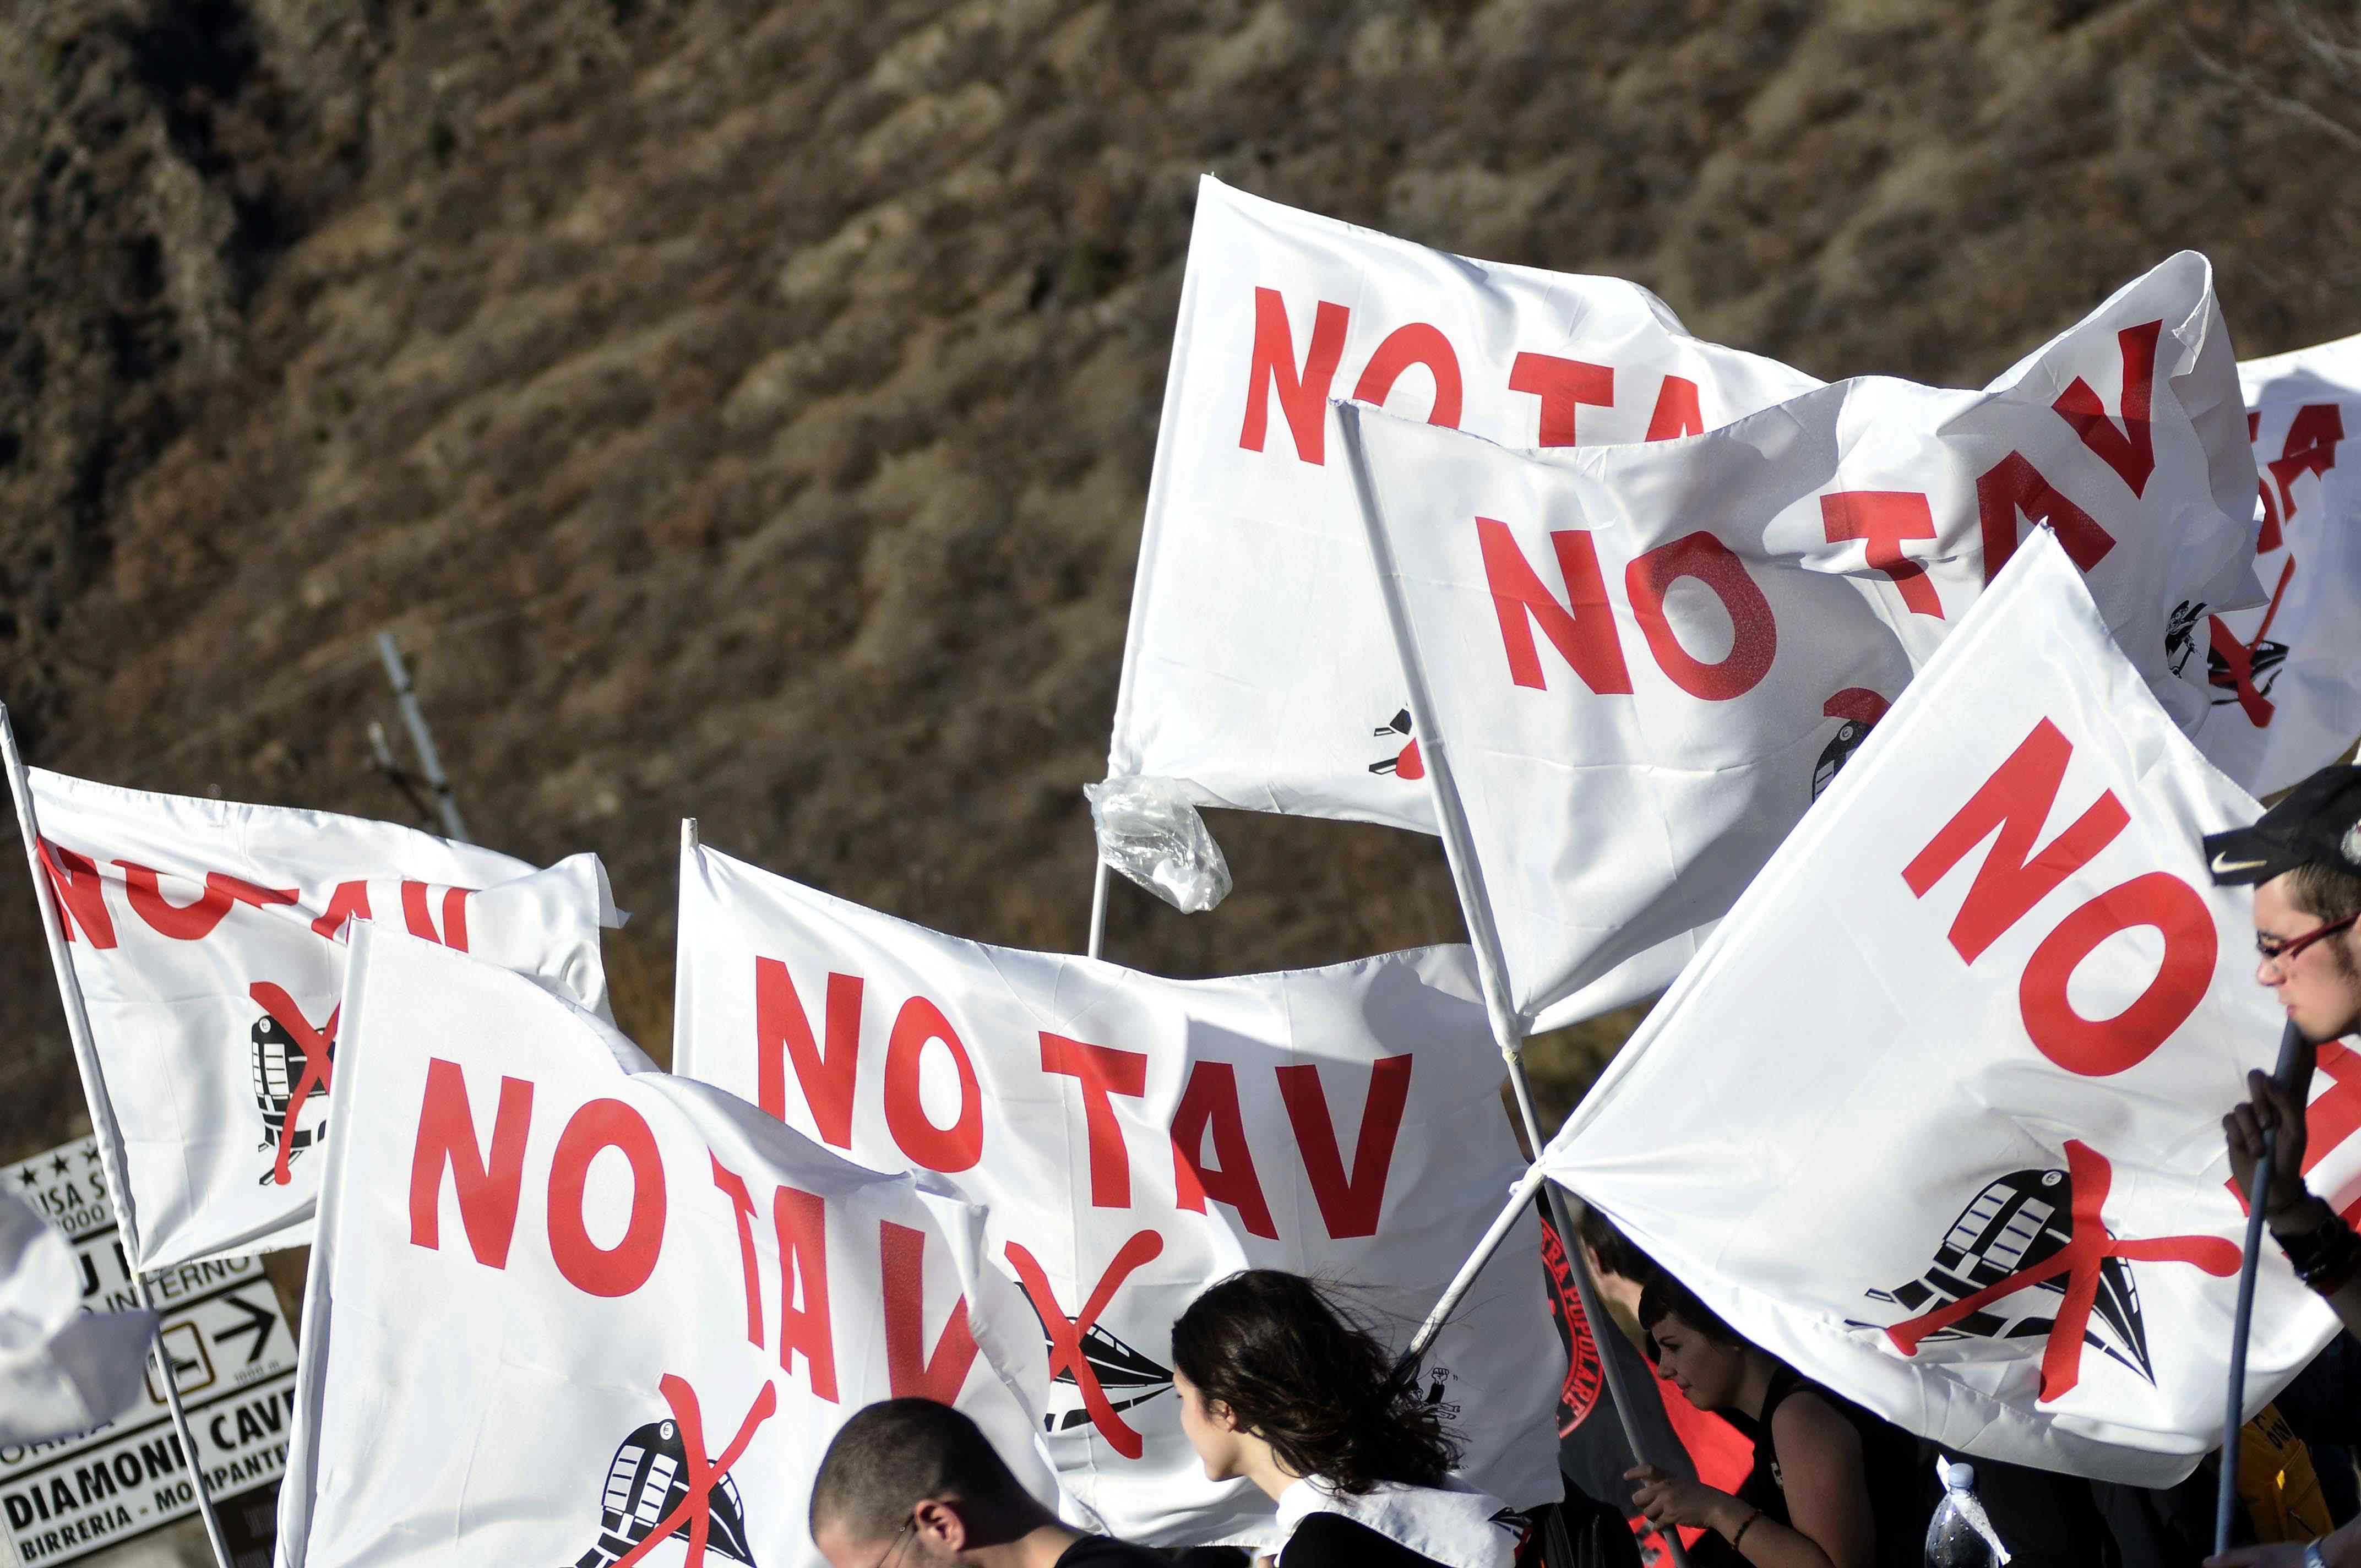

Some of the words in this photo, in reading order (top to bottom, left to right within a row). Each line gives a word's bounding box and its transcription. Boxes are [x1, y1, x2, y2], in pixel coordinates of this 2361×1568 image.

[1239, 285, 1462, 466] NO
[1475, 516, 1777, 701] NO
[1819, 319, 2163, 620] TAV
[1901, 715, 2218, 1076] NO
[756, 955, 983, 1174] NO
[1038, 1031, 1413, 1241] TAV
[106, 1257, 251, 1313] INERNO
[410, 1057, 666, 1298] NO
[707, 1144, 980, 1407] TAV
[1562, 1285, 1602, 1418] POPOLARE
[19, 1506, 133, 1562] BIRRERIA
